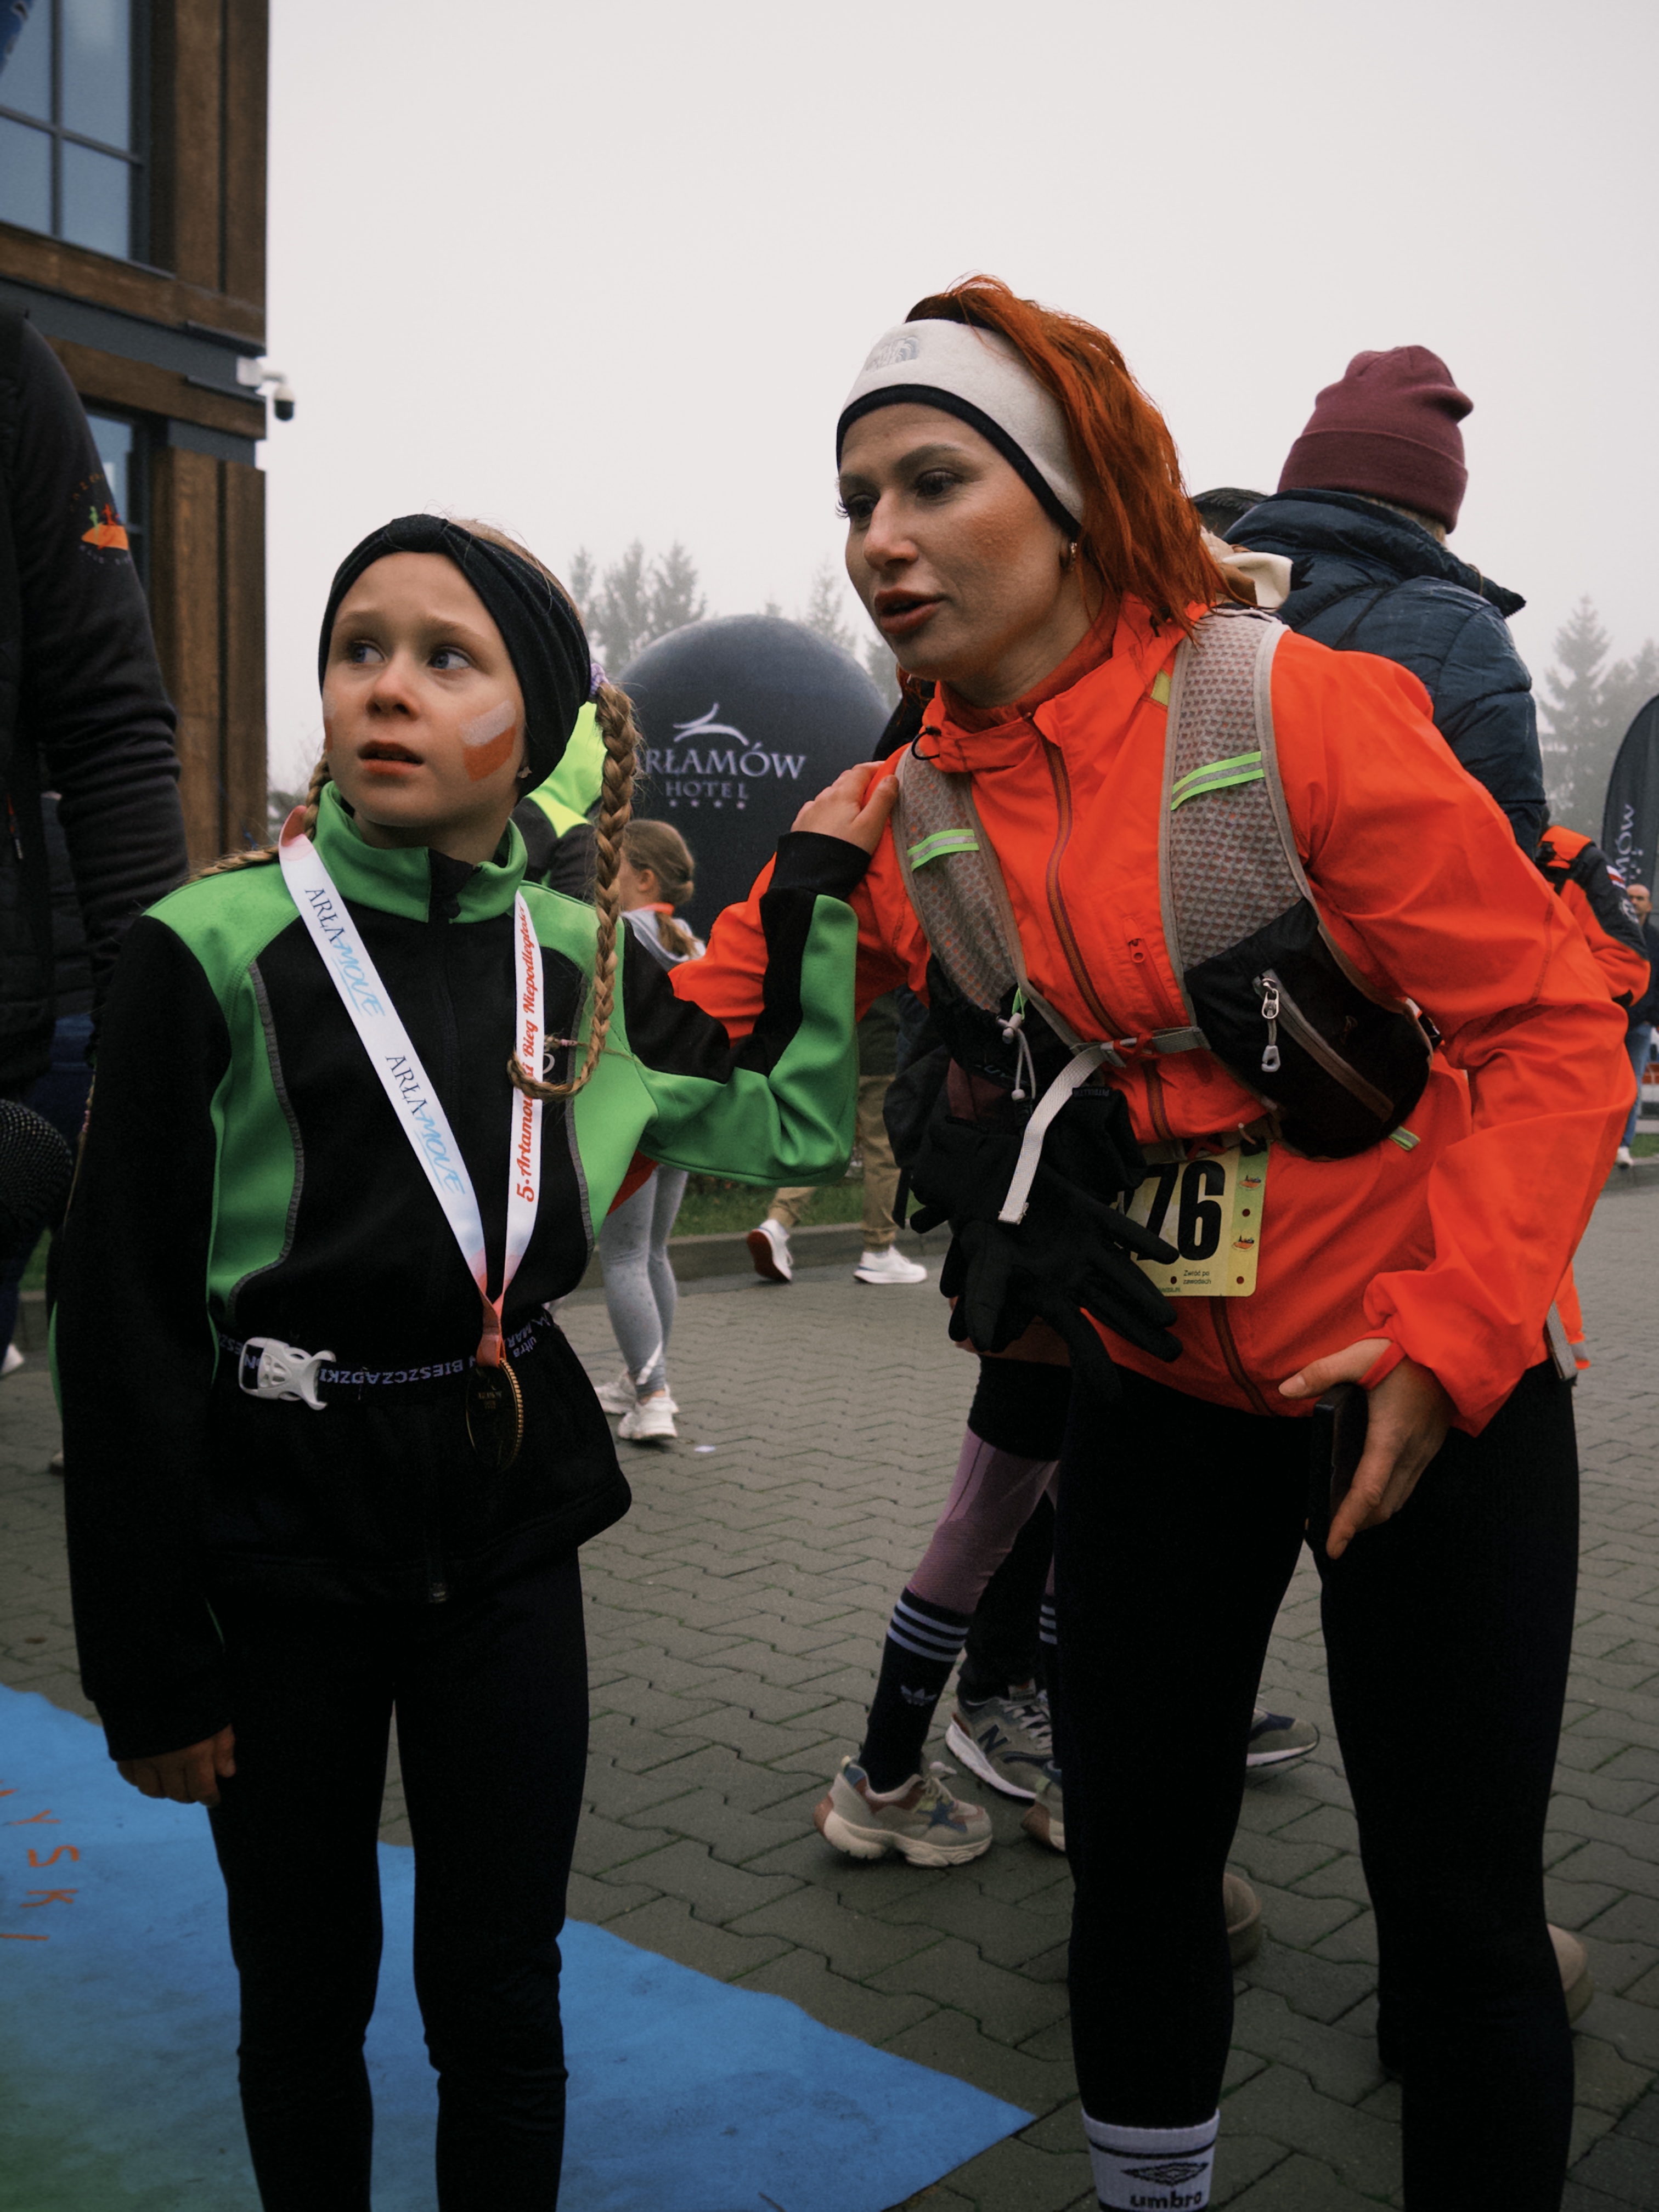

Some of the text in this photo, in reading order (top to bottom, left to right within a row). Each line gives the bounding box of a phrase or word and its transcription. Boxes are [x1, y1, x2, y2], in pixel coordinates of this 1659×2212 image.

[665, 780, 750, 800] HOTEL
[523, 1020, 539, 1057] Bieg
[1125, 1159, 1226, 1261] 76
[513, 1336, 537, 1358] ultra
[1130, 2190, 1203, 2209] umbro
